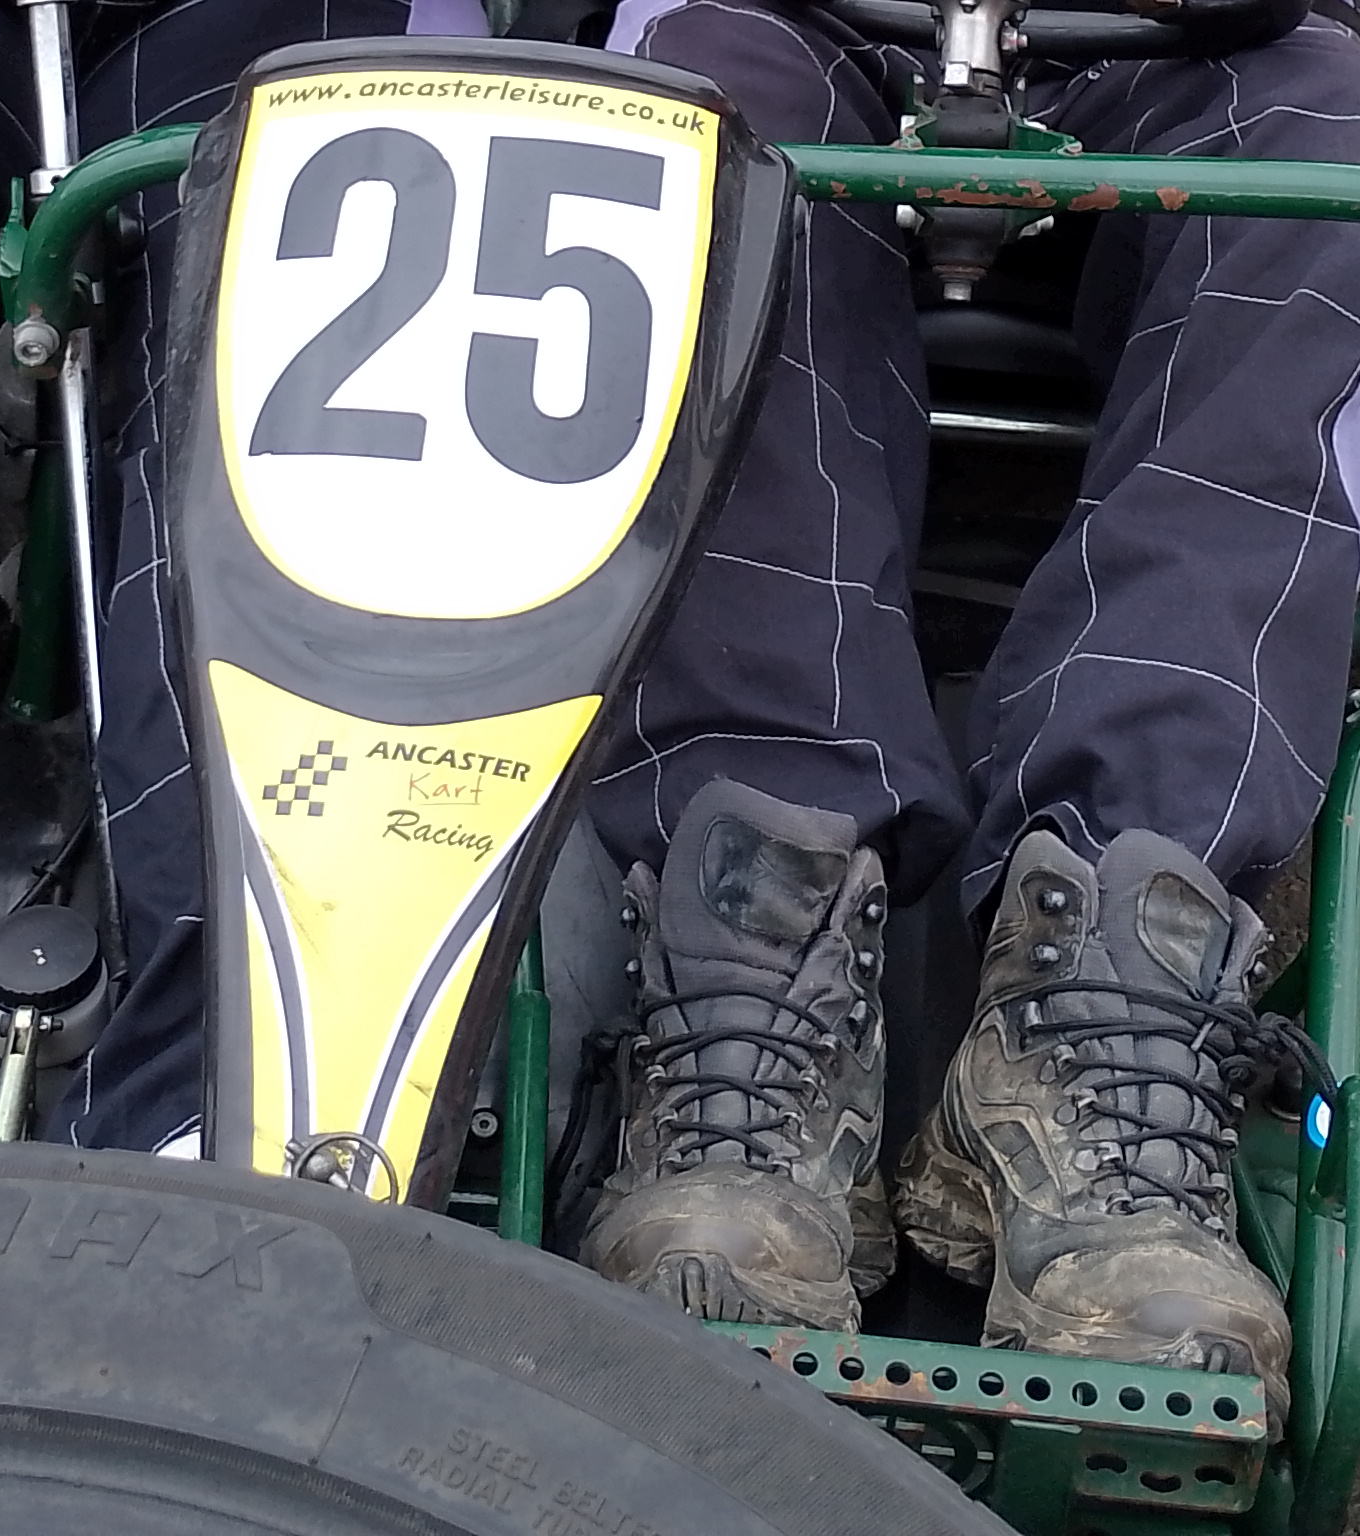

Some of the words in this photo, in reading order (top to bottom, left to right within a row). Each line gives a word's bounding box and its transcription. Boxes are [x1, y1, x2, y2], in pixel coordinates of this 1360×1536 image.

[268, 77, 706, 136] www.ancasterleisure.co.uk
[248, 126, 666, 485] 25
[364, 740, 532, 783] ANCASTER
[407, 772, 484, 805] Kart
[381, 808, 495, 863] Racing
[397, 1445, 513, 1515] RADIAL
[447, 1426, 539, 1491] STEEL
